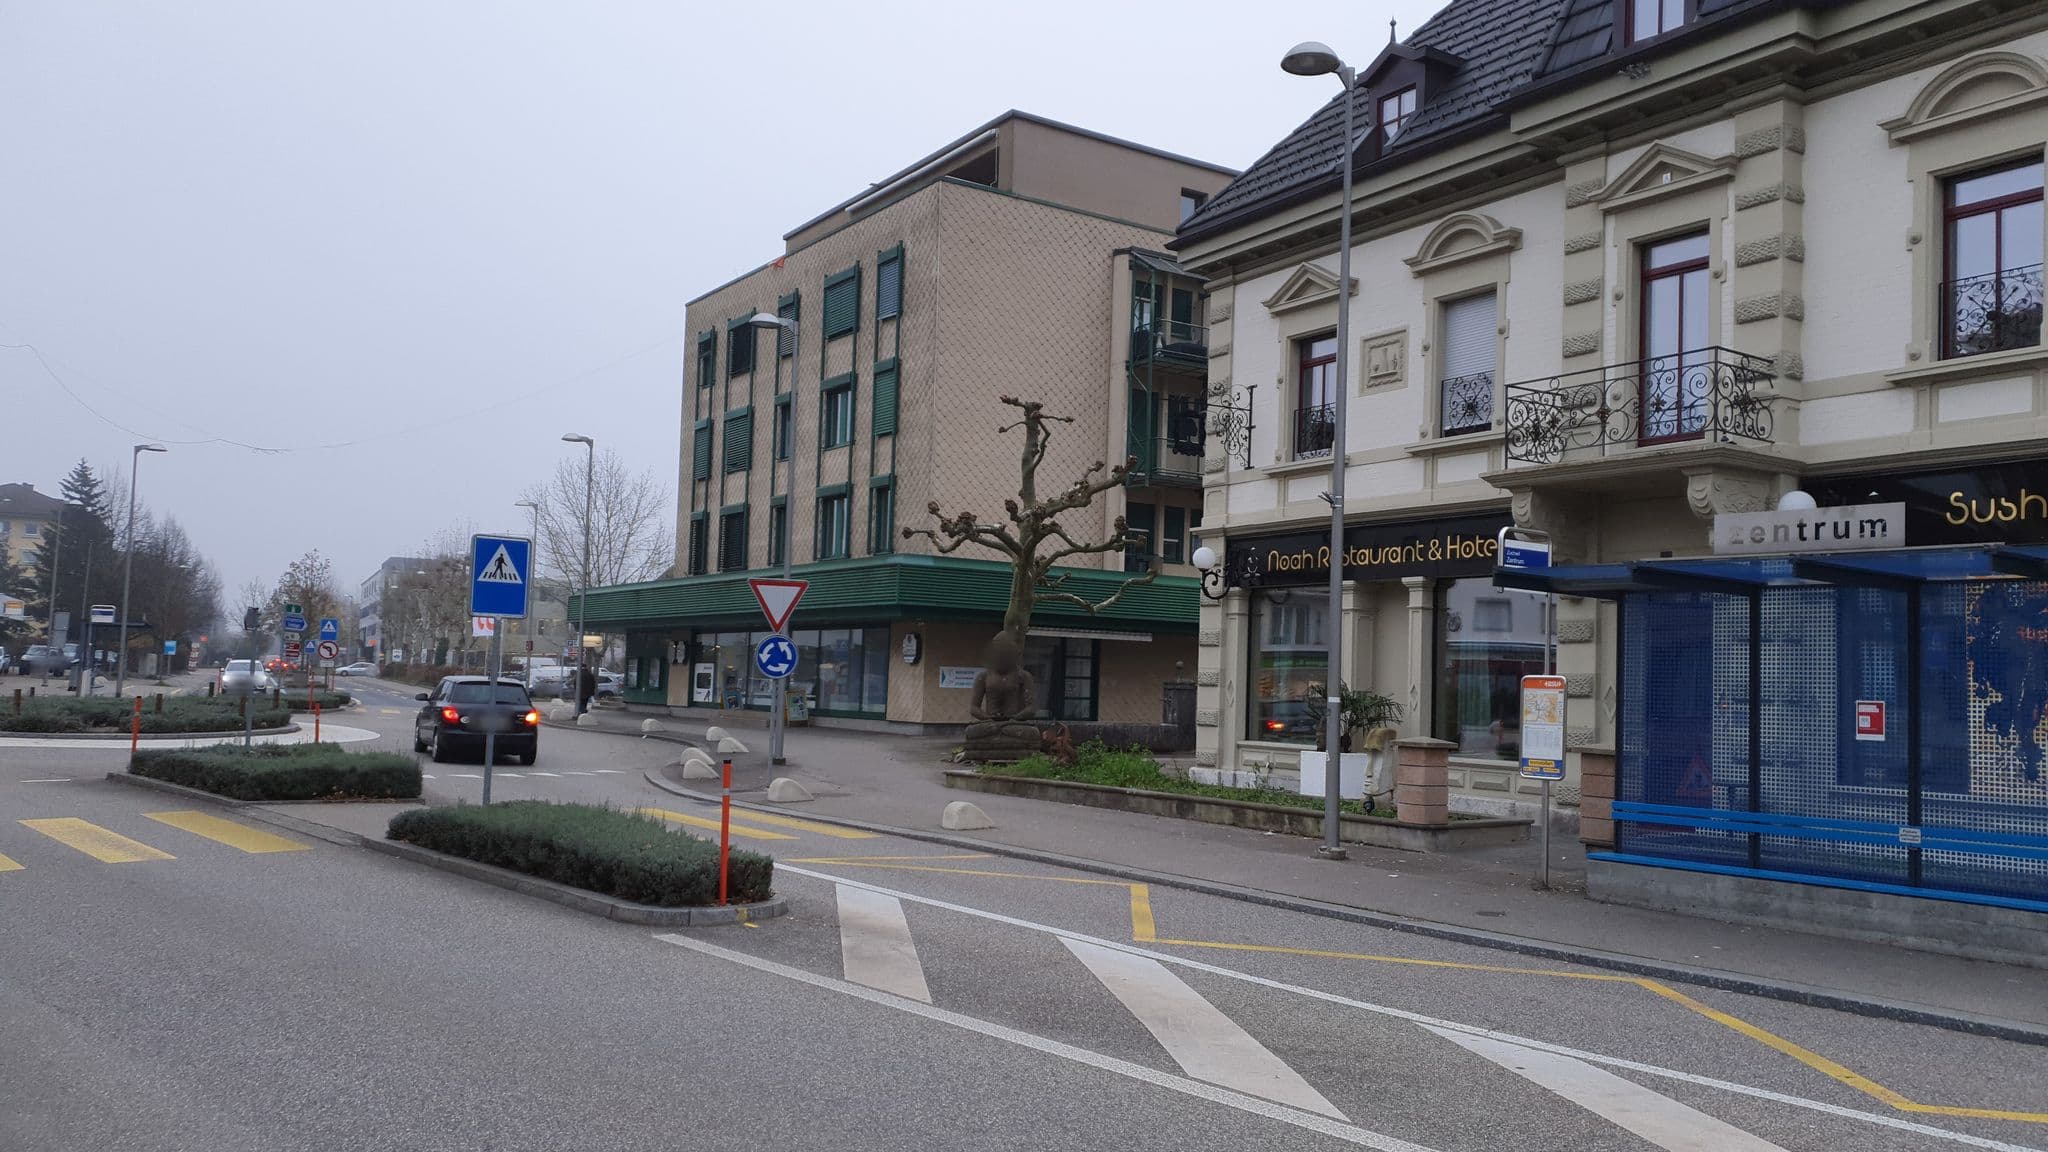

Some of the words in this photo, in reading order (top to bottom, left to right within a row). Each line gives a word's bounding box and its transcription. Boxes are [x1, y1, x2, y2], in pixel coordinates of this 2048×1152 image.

[1945, 488, 2048, 525] Sush
[1268, 549, 1314, 572] Noah
[1317, 540, 1425, 569] Rstaurant
[1428, 538, 1443, 561] &
[1447, 535, 1499, 560] Hote
